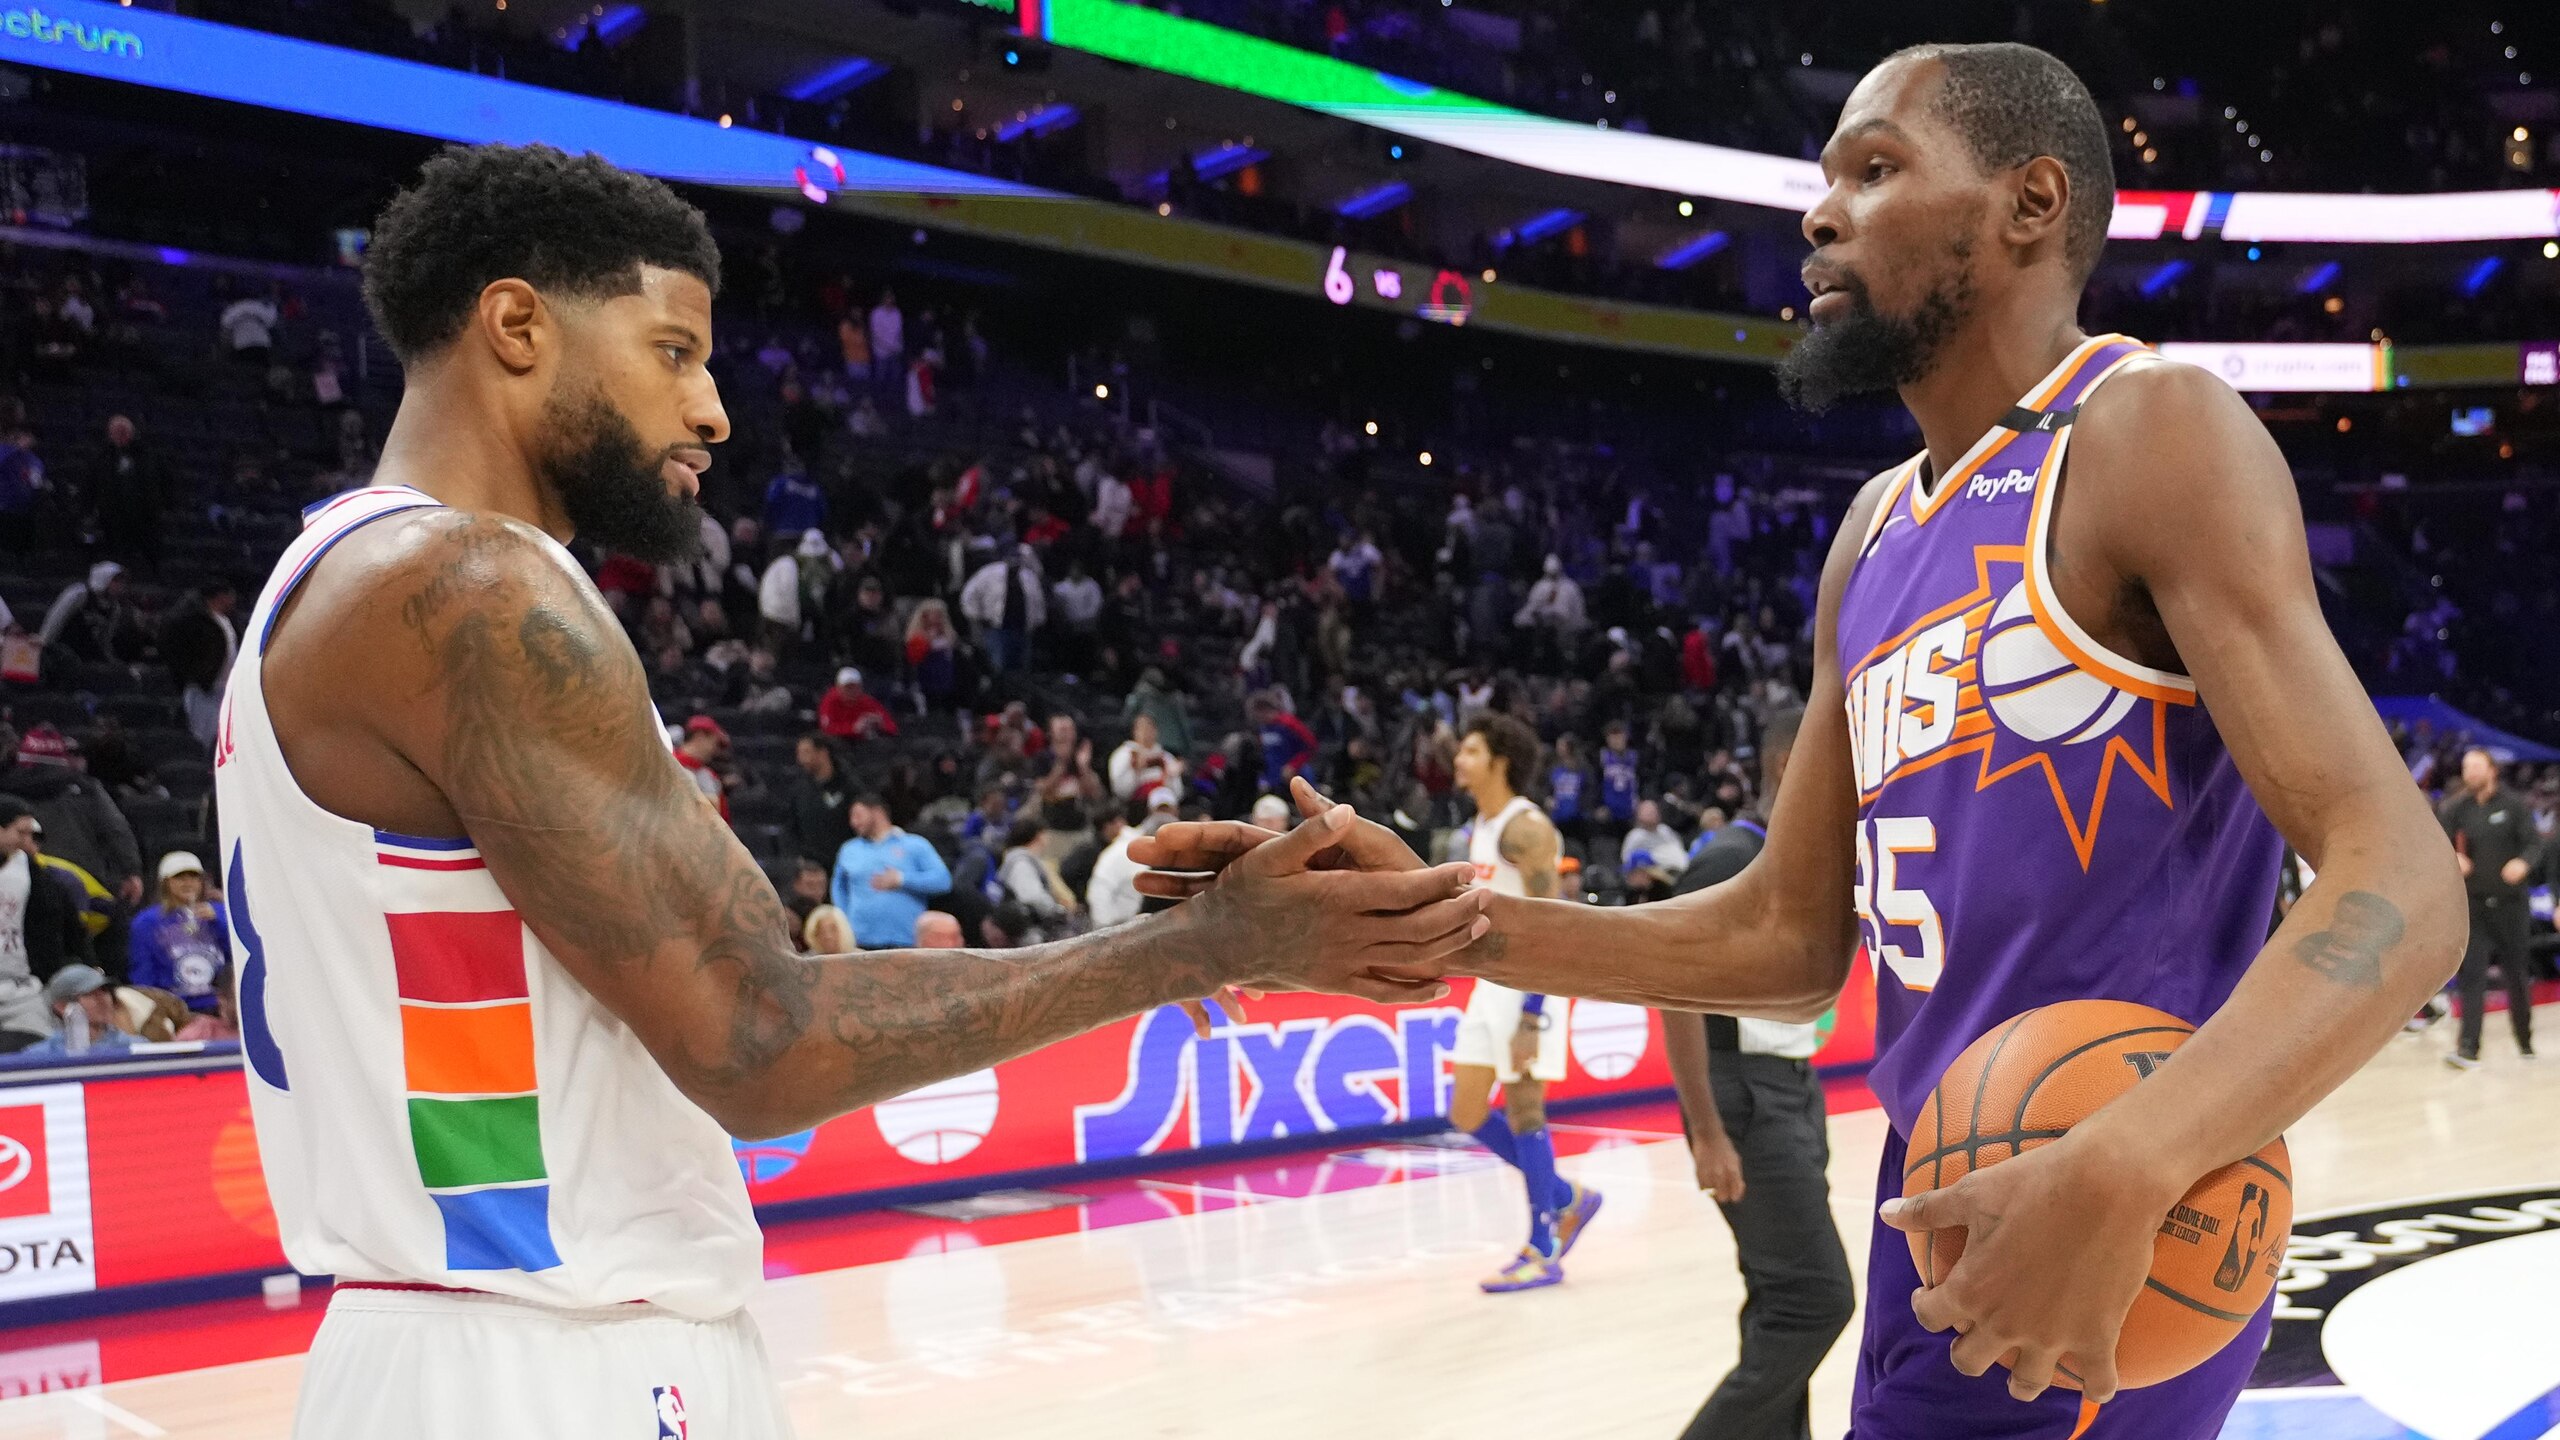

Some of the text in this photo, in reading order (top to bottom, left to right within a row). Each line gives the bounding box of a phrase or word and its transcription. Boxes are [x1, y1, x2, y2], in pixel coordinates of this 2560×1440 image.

[0, 8, 144, 59] ctrum
[1966, 466, 2040, 503] PayPal
[1073, 998, 1500, 1166] Sixer
[2176, 1205, 2203, 1229] GAME
[2200, 1213, 2220, 1236] BALL
